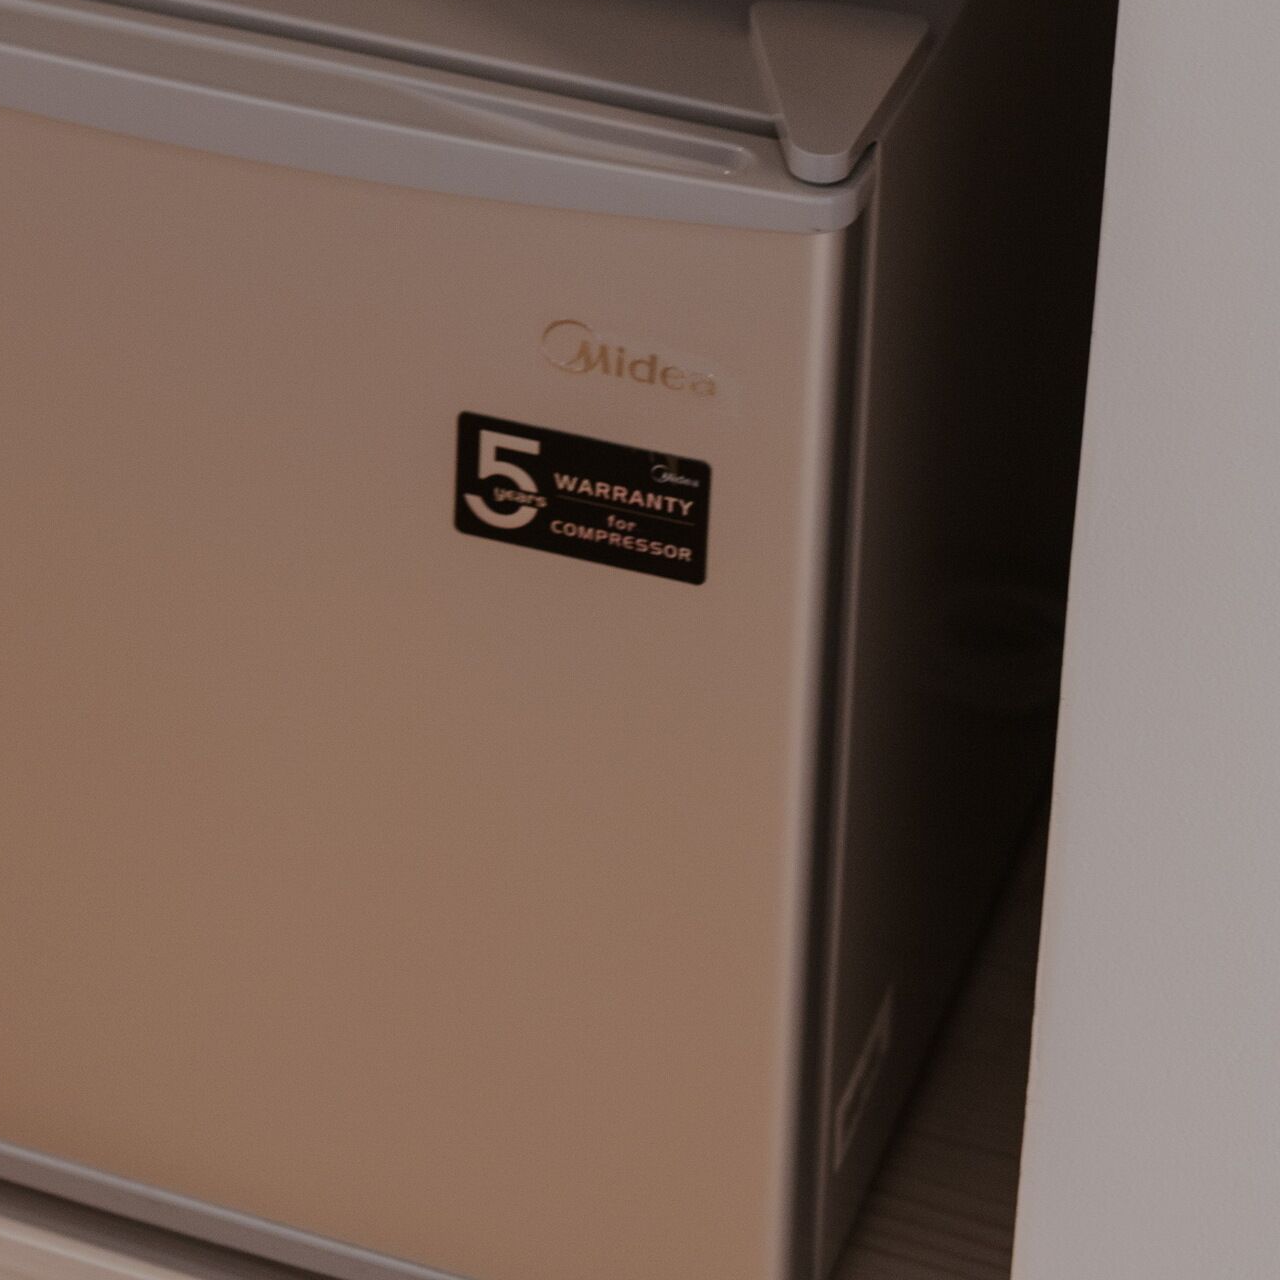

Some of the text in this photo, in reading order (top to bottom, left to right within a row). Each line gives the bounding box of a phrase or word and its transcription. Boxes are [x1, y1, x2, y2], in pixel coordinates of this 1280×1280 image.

[541, 319, 717, 396] Midea
[464, 429, 548, 530] 5 years
[553, 472, 694, 517] WARRANTY
[550, 520, 693, 562] COMPRESSOR
[606, 514, 637, 533] for
